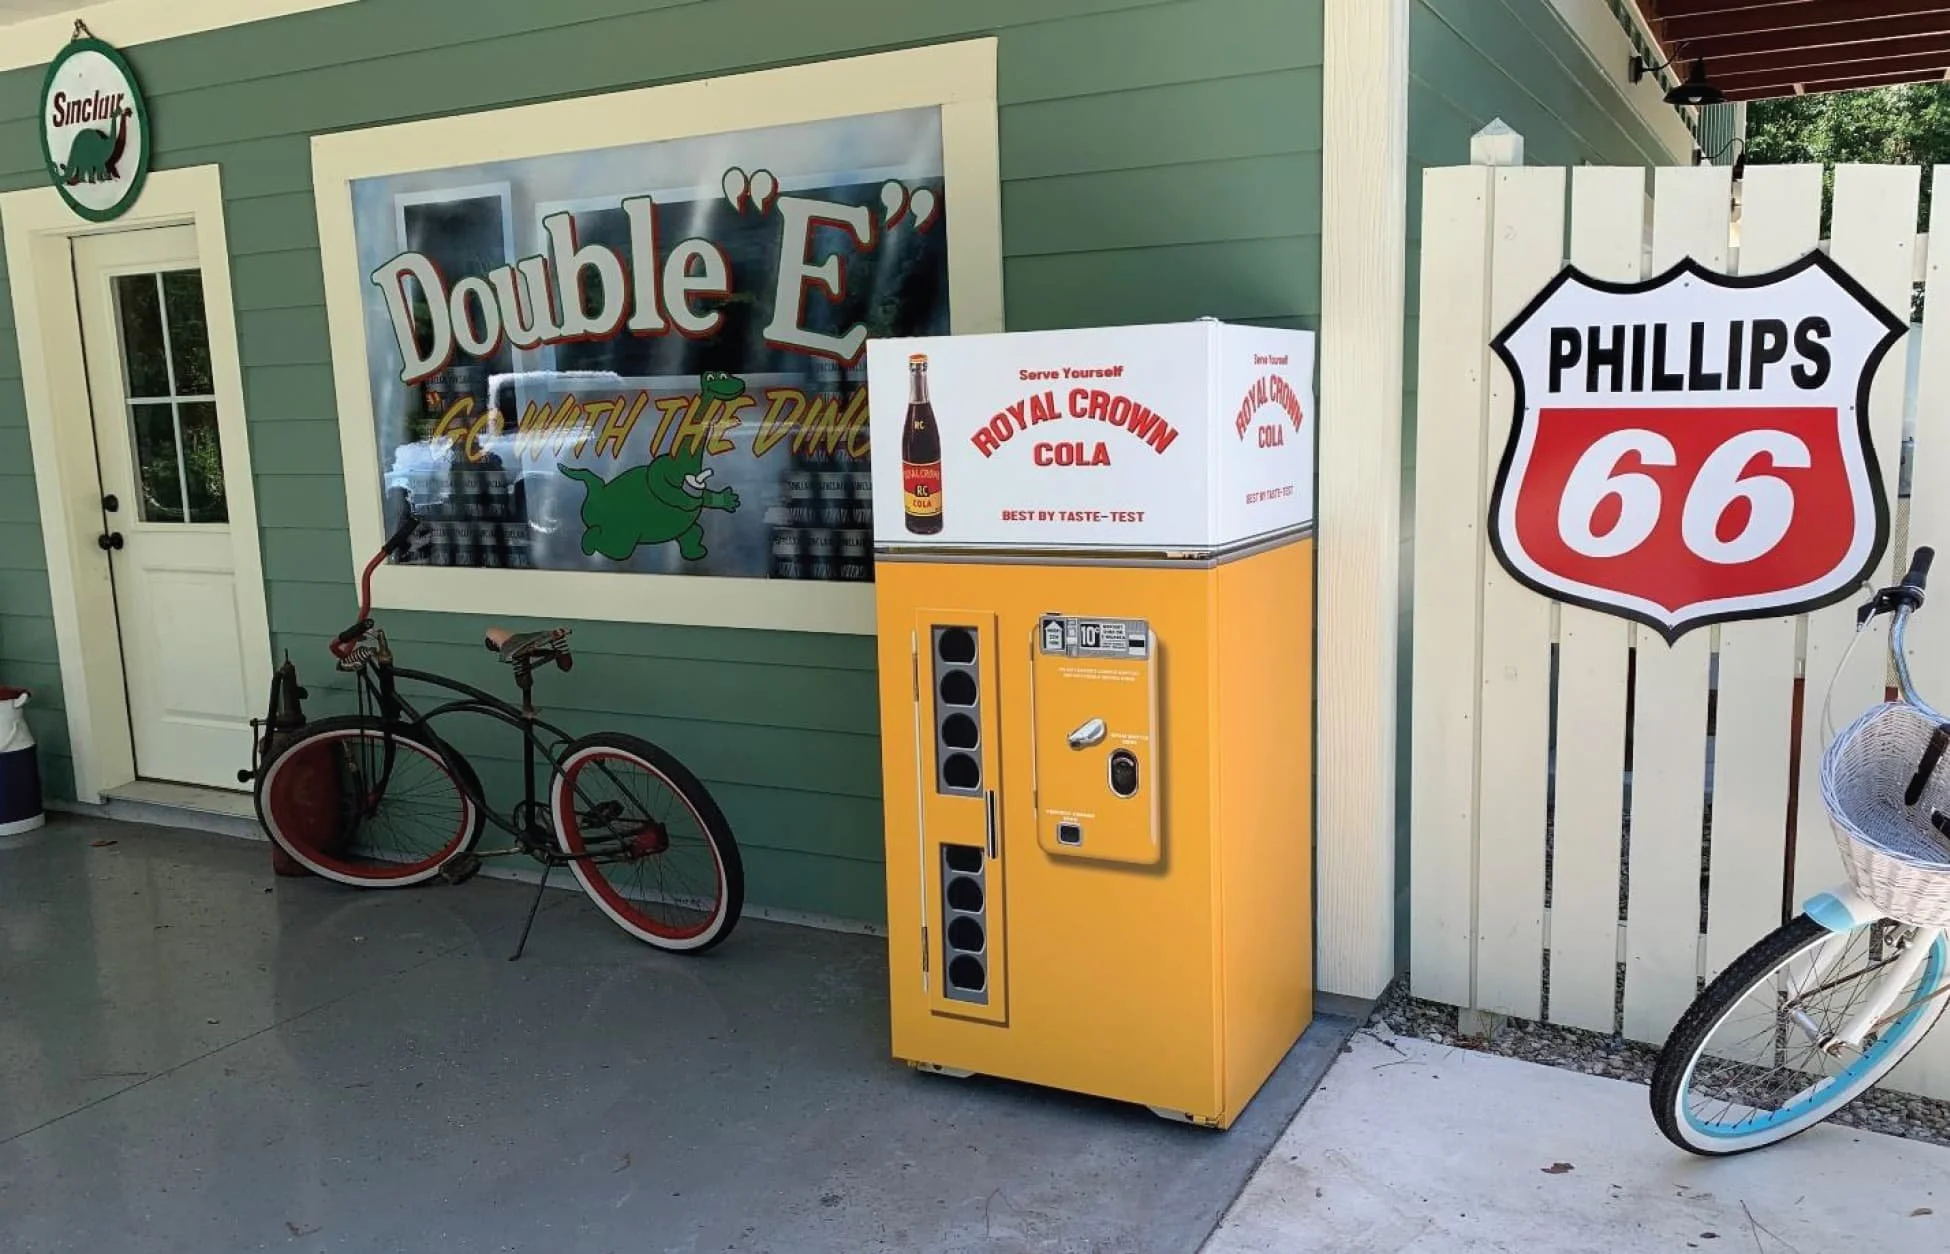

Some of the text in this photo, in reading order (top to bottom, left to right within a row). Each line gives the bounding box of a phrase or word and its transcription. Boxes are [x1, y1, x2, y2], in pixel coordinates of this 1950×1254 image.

[53, 89, 124, 127] Sinclair
[370, 195, 732, 384] Double
[1019, 365, 1124, 381] Serve Yourself
[1549, 316, 1831, 393] PHILLIPS
[514, 390, 649, 461] WITH
[650, 392, 756, 459] THE
[970, 387, 1179, 459] ROYAL CROWN
[1235, 373, 1304, 442] ROYAL CROWN
[1034, 441, 1111, 467] COLA
[1258, 424, 1284, 449] COLA
[912, 499, 932, 508] COLA
[917, 485, 928, 496] RC
[1557, 428, 1812, 565] 66
[1002, 510, 1145, 523] BEST BY TASTE-TEST
